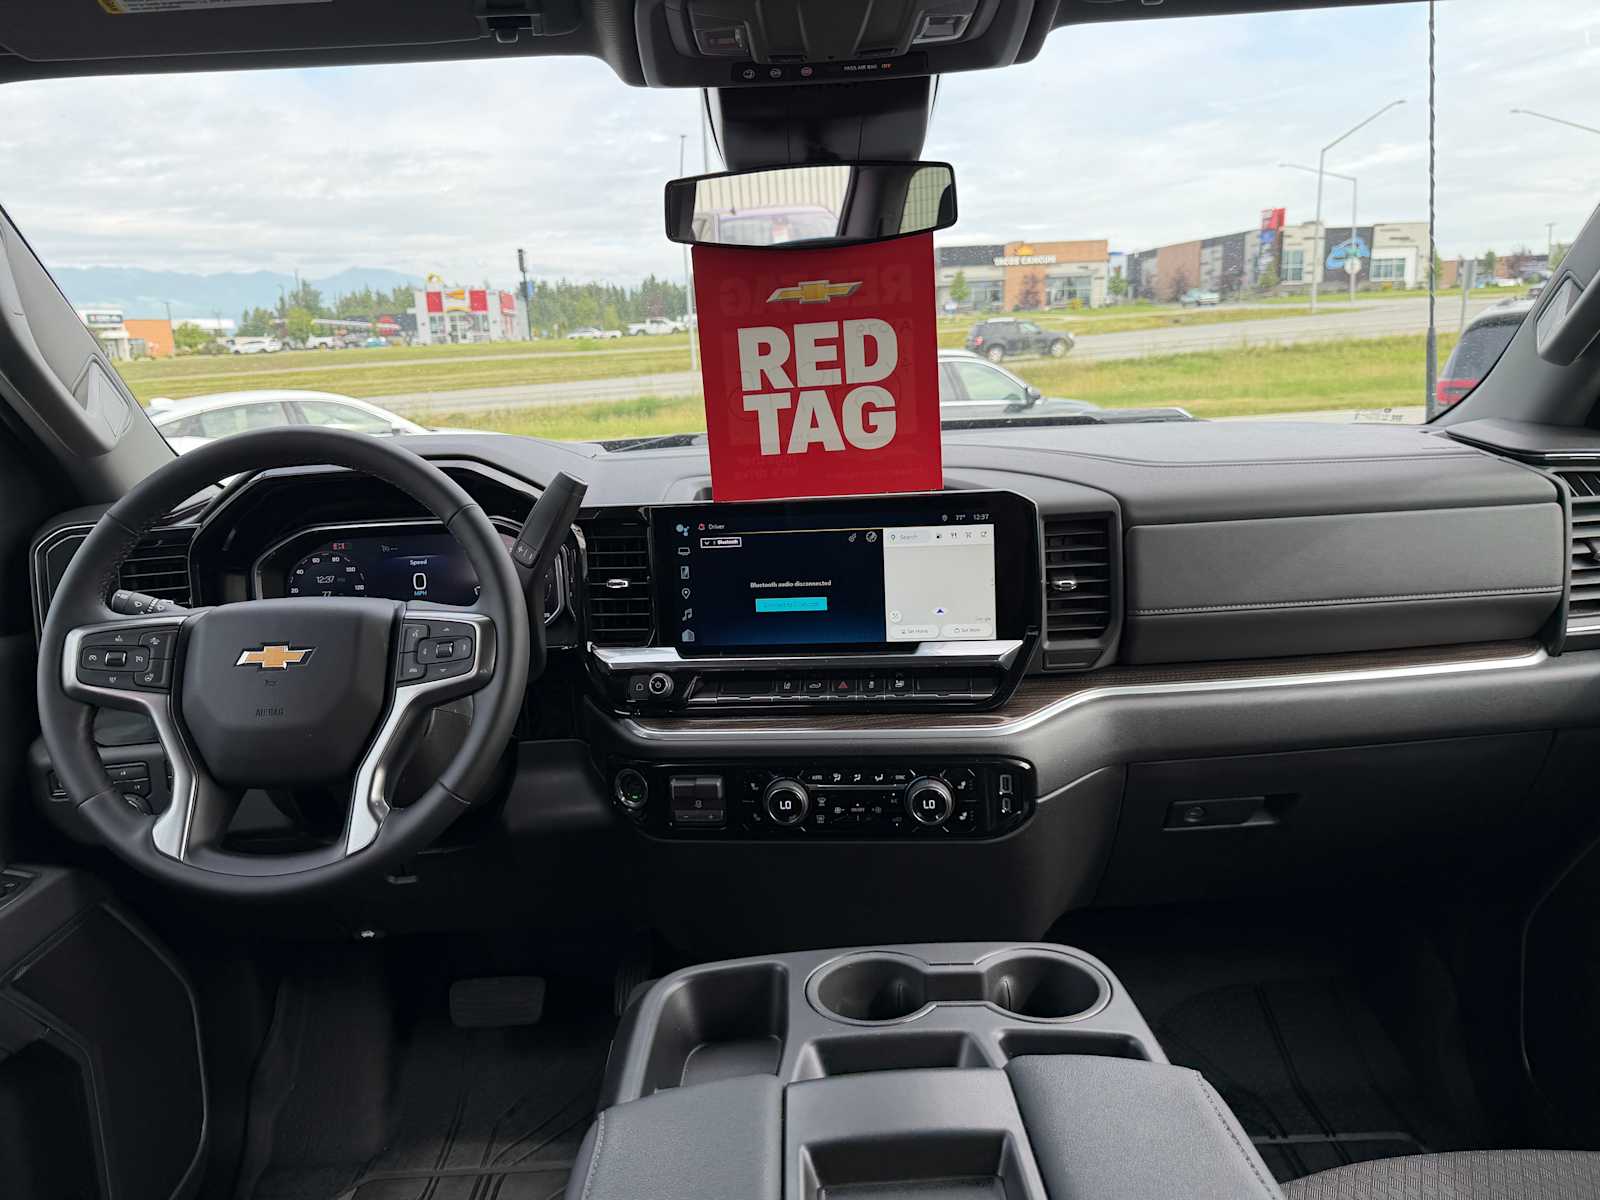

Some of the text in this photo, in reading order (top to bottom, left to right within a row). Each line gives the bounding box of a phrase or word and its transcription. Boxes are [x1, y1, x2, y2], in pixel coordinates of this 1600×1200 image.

[737, 318, 898, 392] RED
[743, 385, 896, 456] TAG
[316, 575, 335, 583] 12:37
[413, 572, 427, 590] 0
[750, 581, 778, 589] Bluetooth
[794, 580, 832, 588] disconnected
[780, 800, 792, 810] LO
[923, 800, 936, 809] LO
